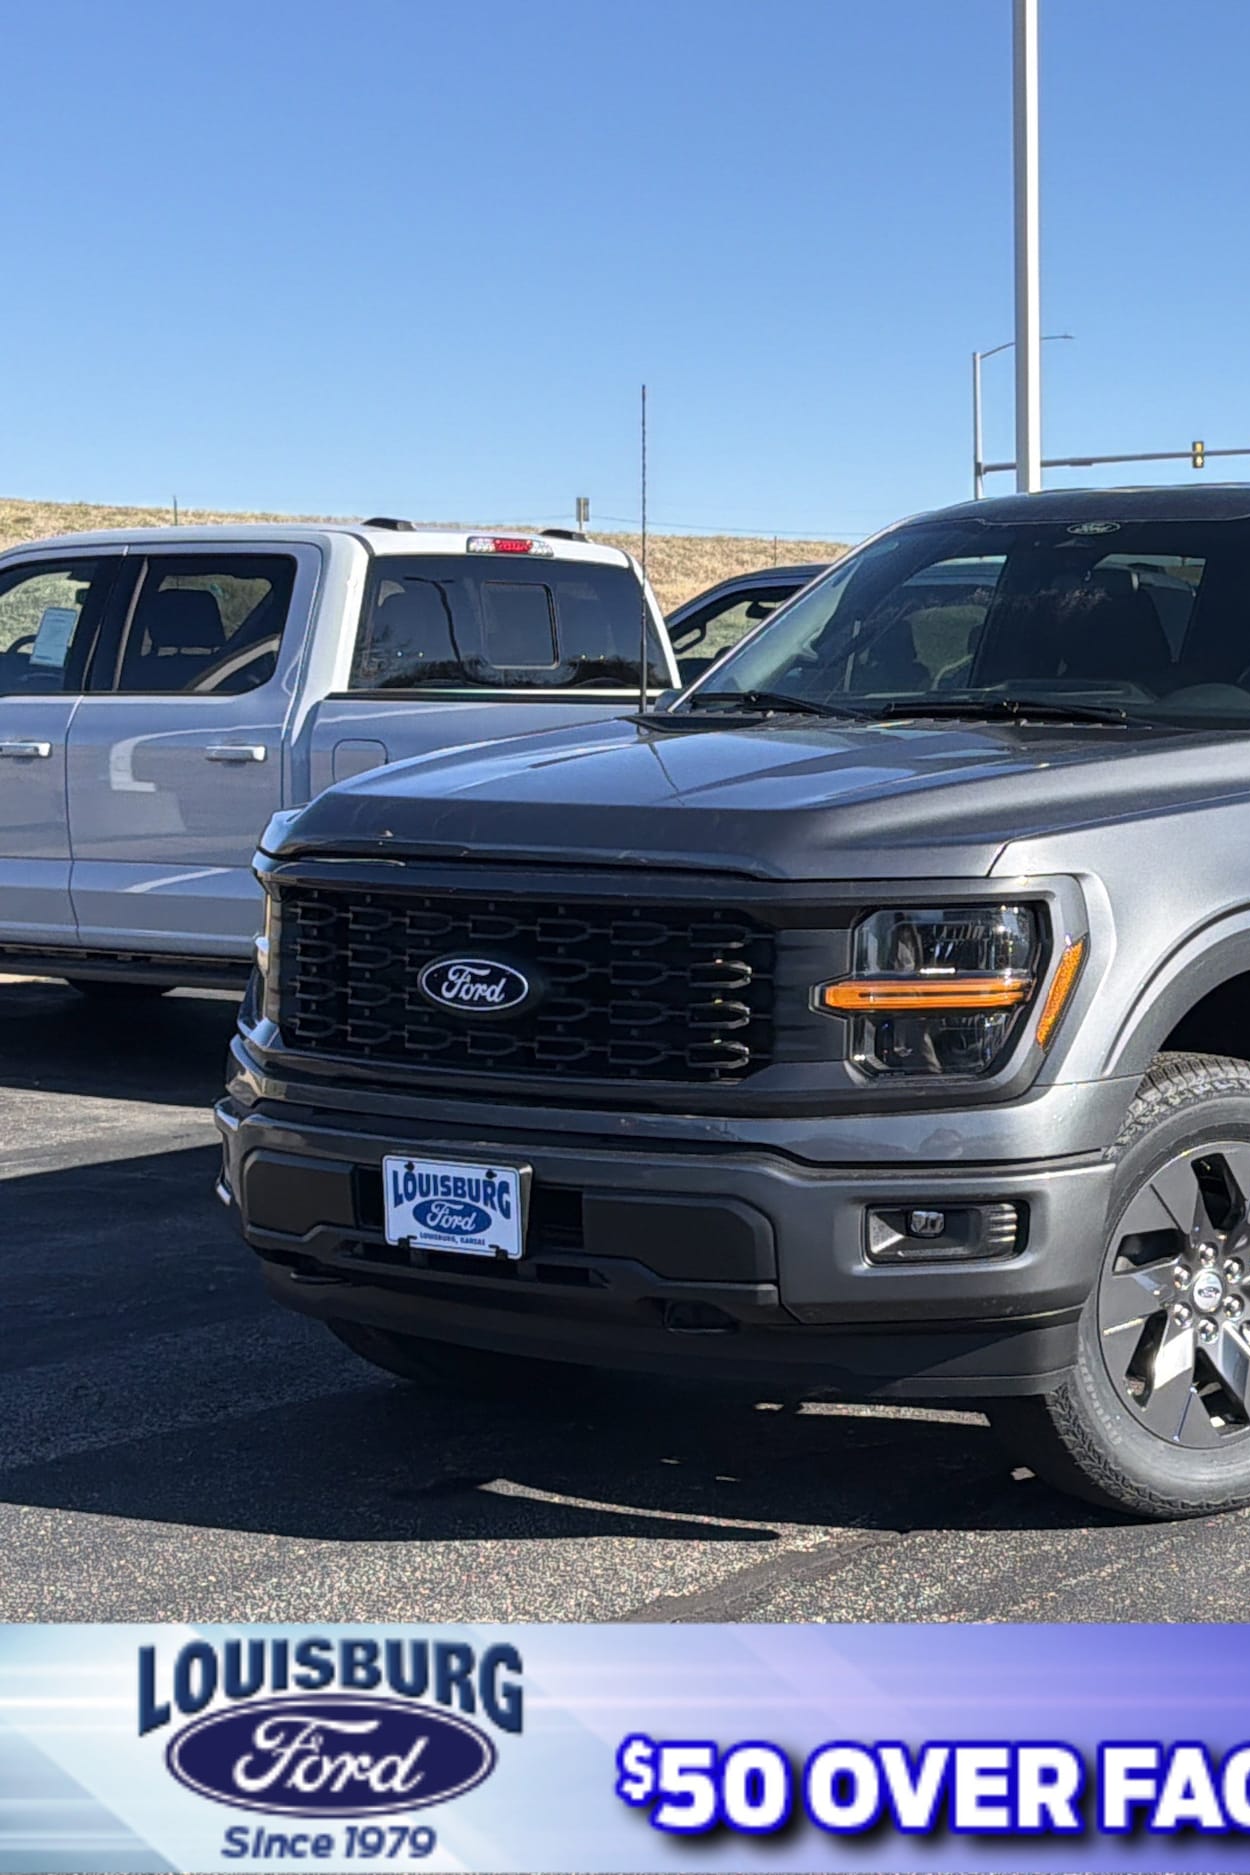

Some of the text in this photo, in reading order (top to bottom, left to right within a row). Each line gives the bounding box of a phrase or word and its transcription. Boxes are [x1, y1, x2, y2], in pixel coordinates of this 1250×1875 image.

[441, 965, 507, 1002] Ford
[392, 1170, 512, 1220] LOUISBURG
[426, 1200, 478, 1231] Ford
[460, 1236, 486, 1247] KANSAS
